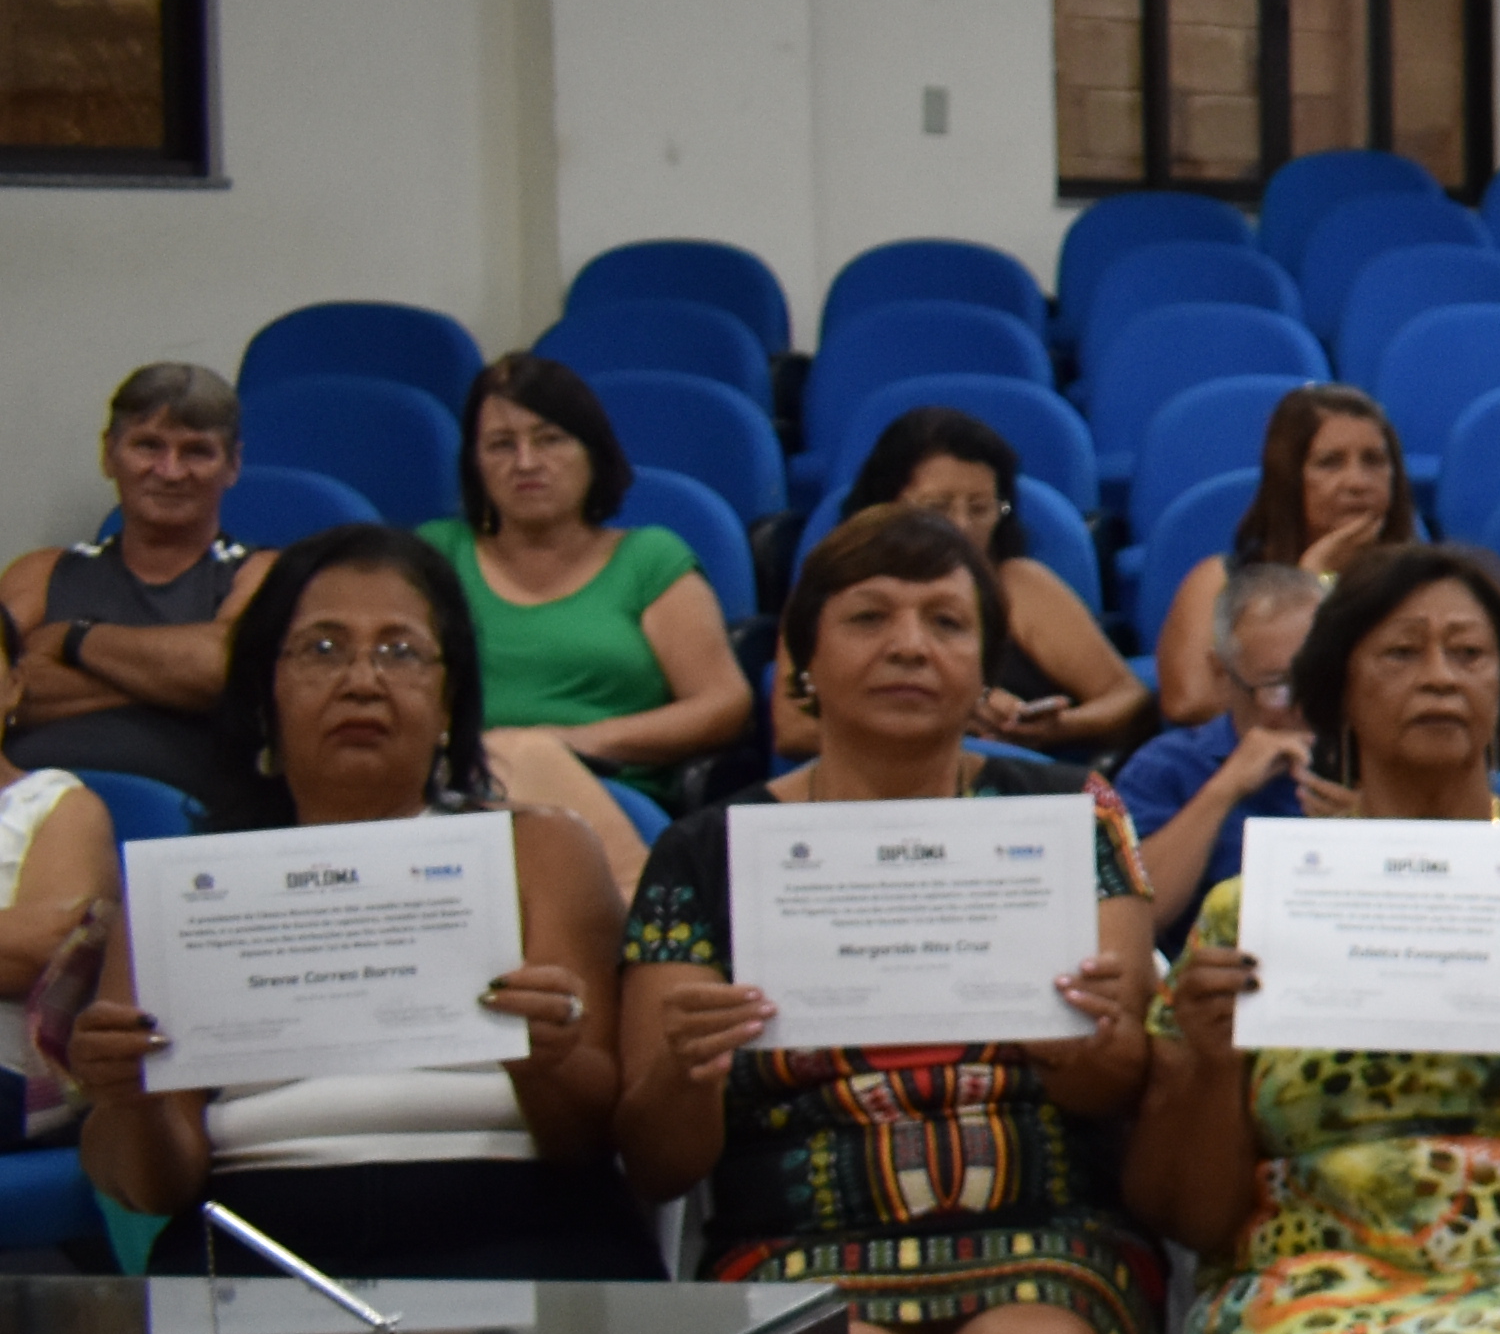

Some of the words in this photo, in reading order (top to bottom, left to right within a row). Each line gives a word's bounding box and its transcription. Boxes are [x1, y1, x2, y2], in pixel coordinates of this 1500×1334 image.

[878, 845, 945, 862] DIPLOMA
[1385, 859, 1449, 875] DIPLOMA
[286, 869, 359, 890] DIPLOMA
[248, 975, 299, 989] Sirene
[362, 965, 417, 980] Barros
